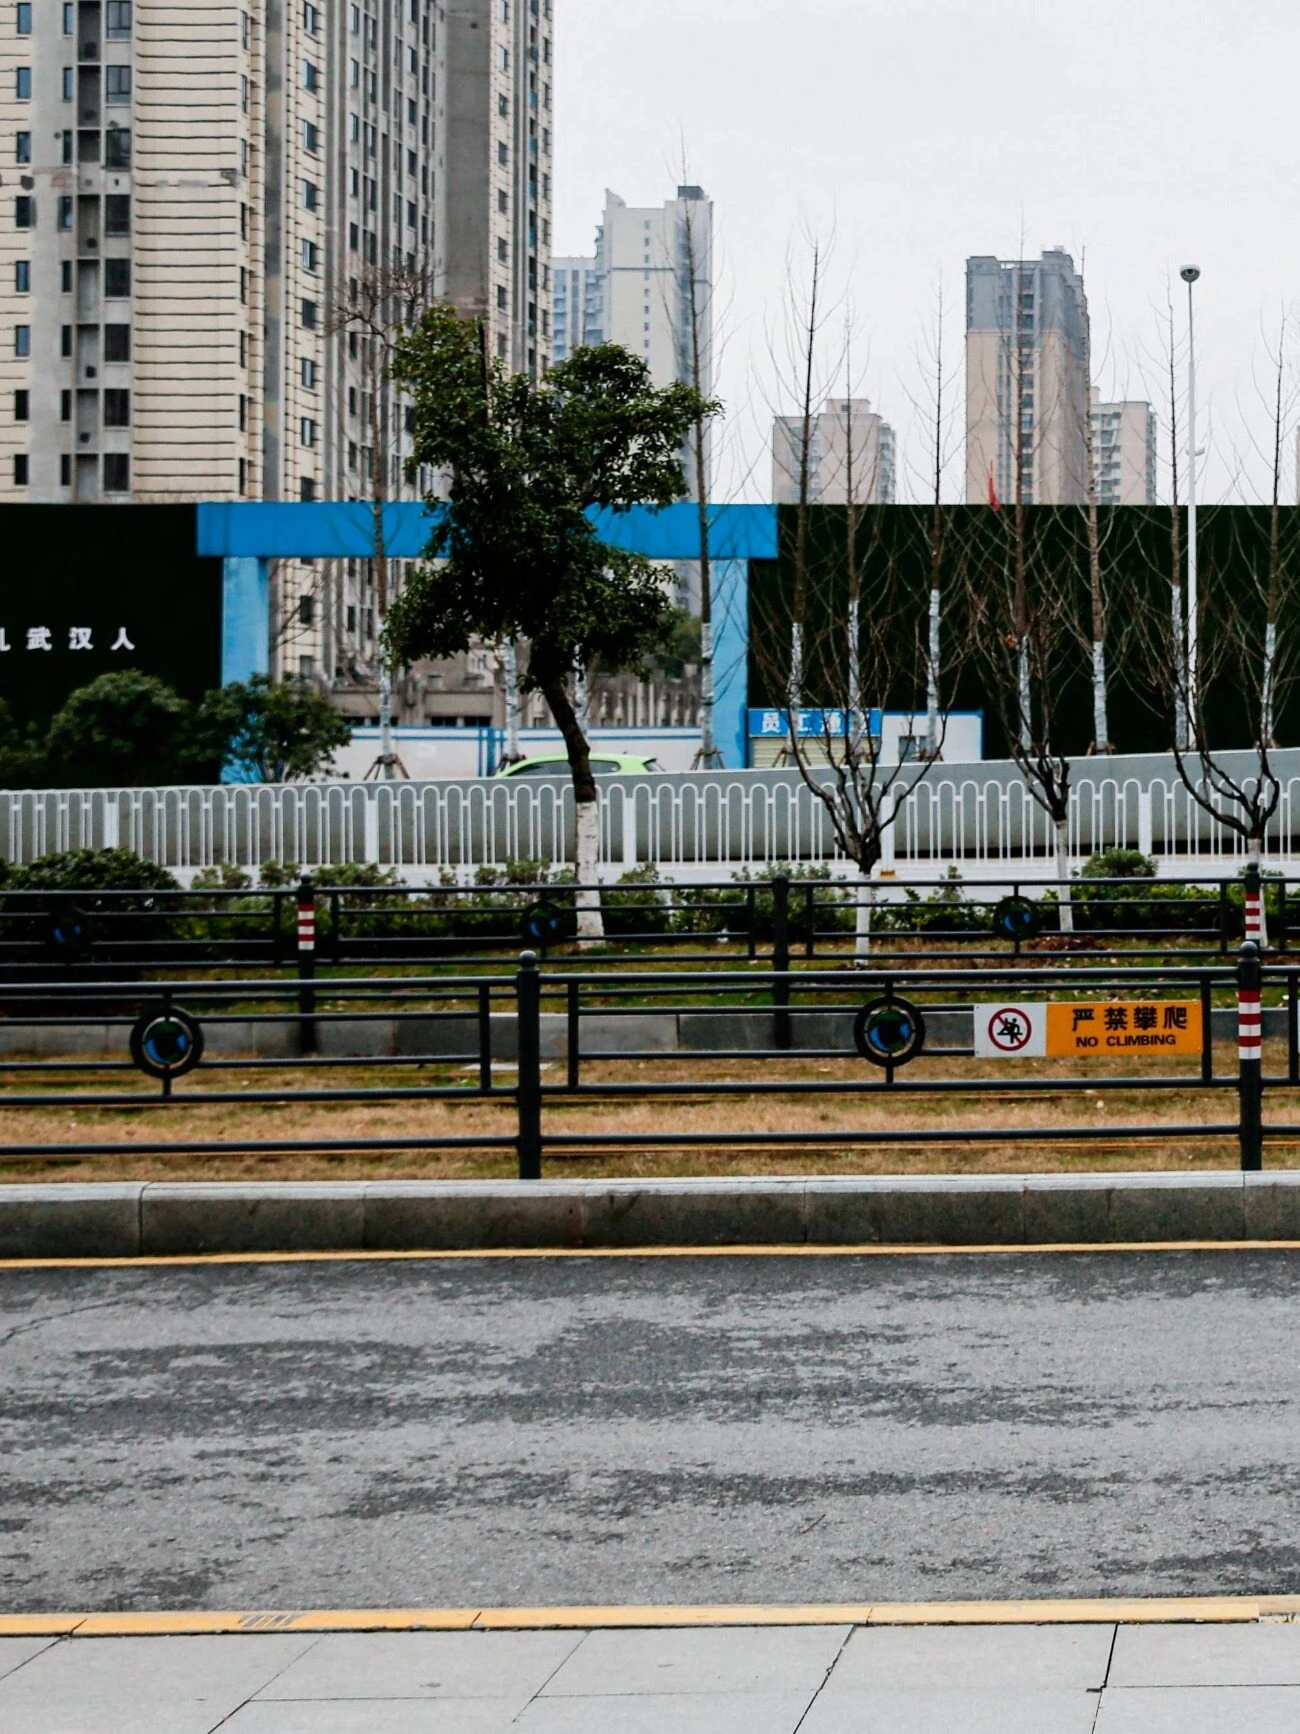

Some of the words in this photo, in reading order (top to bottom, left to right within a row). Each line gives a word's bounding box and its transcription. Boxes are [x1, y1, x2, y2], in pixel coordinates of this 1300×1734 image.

[1071, 1006, 1188, 1032] 严禁攀爬
[1075, 1036, 1099, 1047] NO
[1106, 1034, 1176, 1047] CLIMBING
